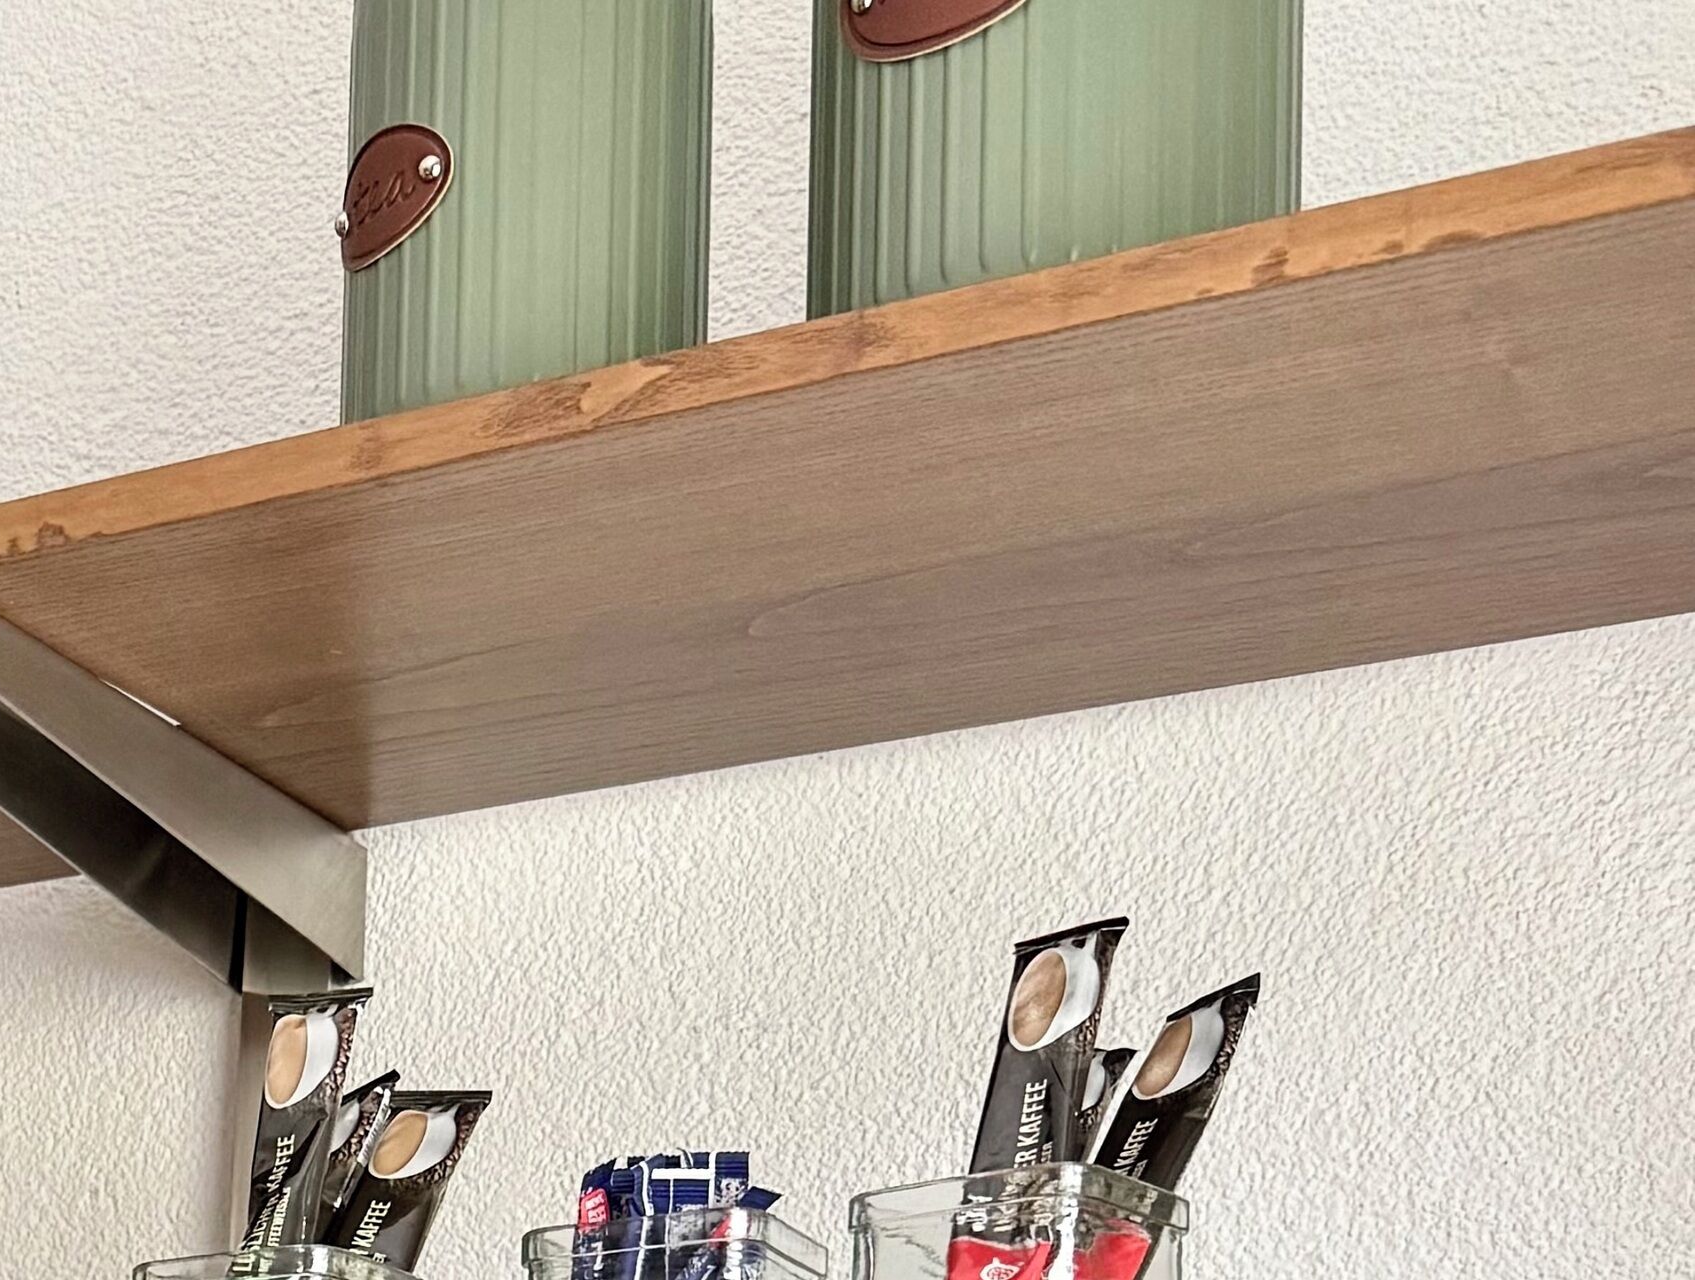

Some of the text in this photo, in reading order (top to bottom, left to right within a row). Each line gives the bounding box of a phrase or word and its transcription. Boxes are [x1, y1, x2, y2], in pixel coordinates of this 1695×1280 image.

[1016, 1078, 1048, 1147] KAFFEE
[266, 1133, 296, 1193] KAFFEE
[1113, 1118, 1159, 1169] KAFFEE
[351, 1199, 392, 1248] KAFFEE
